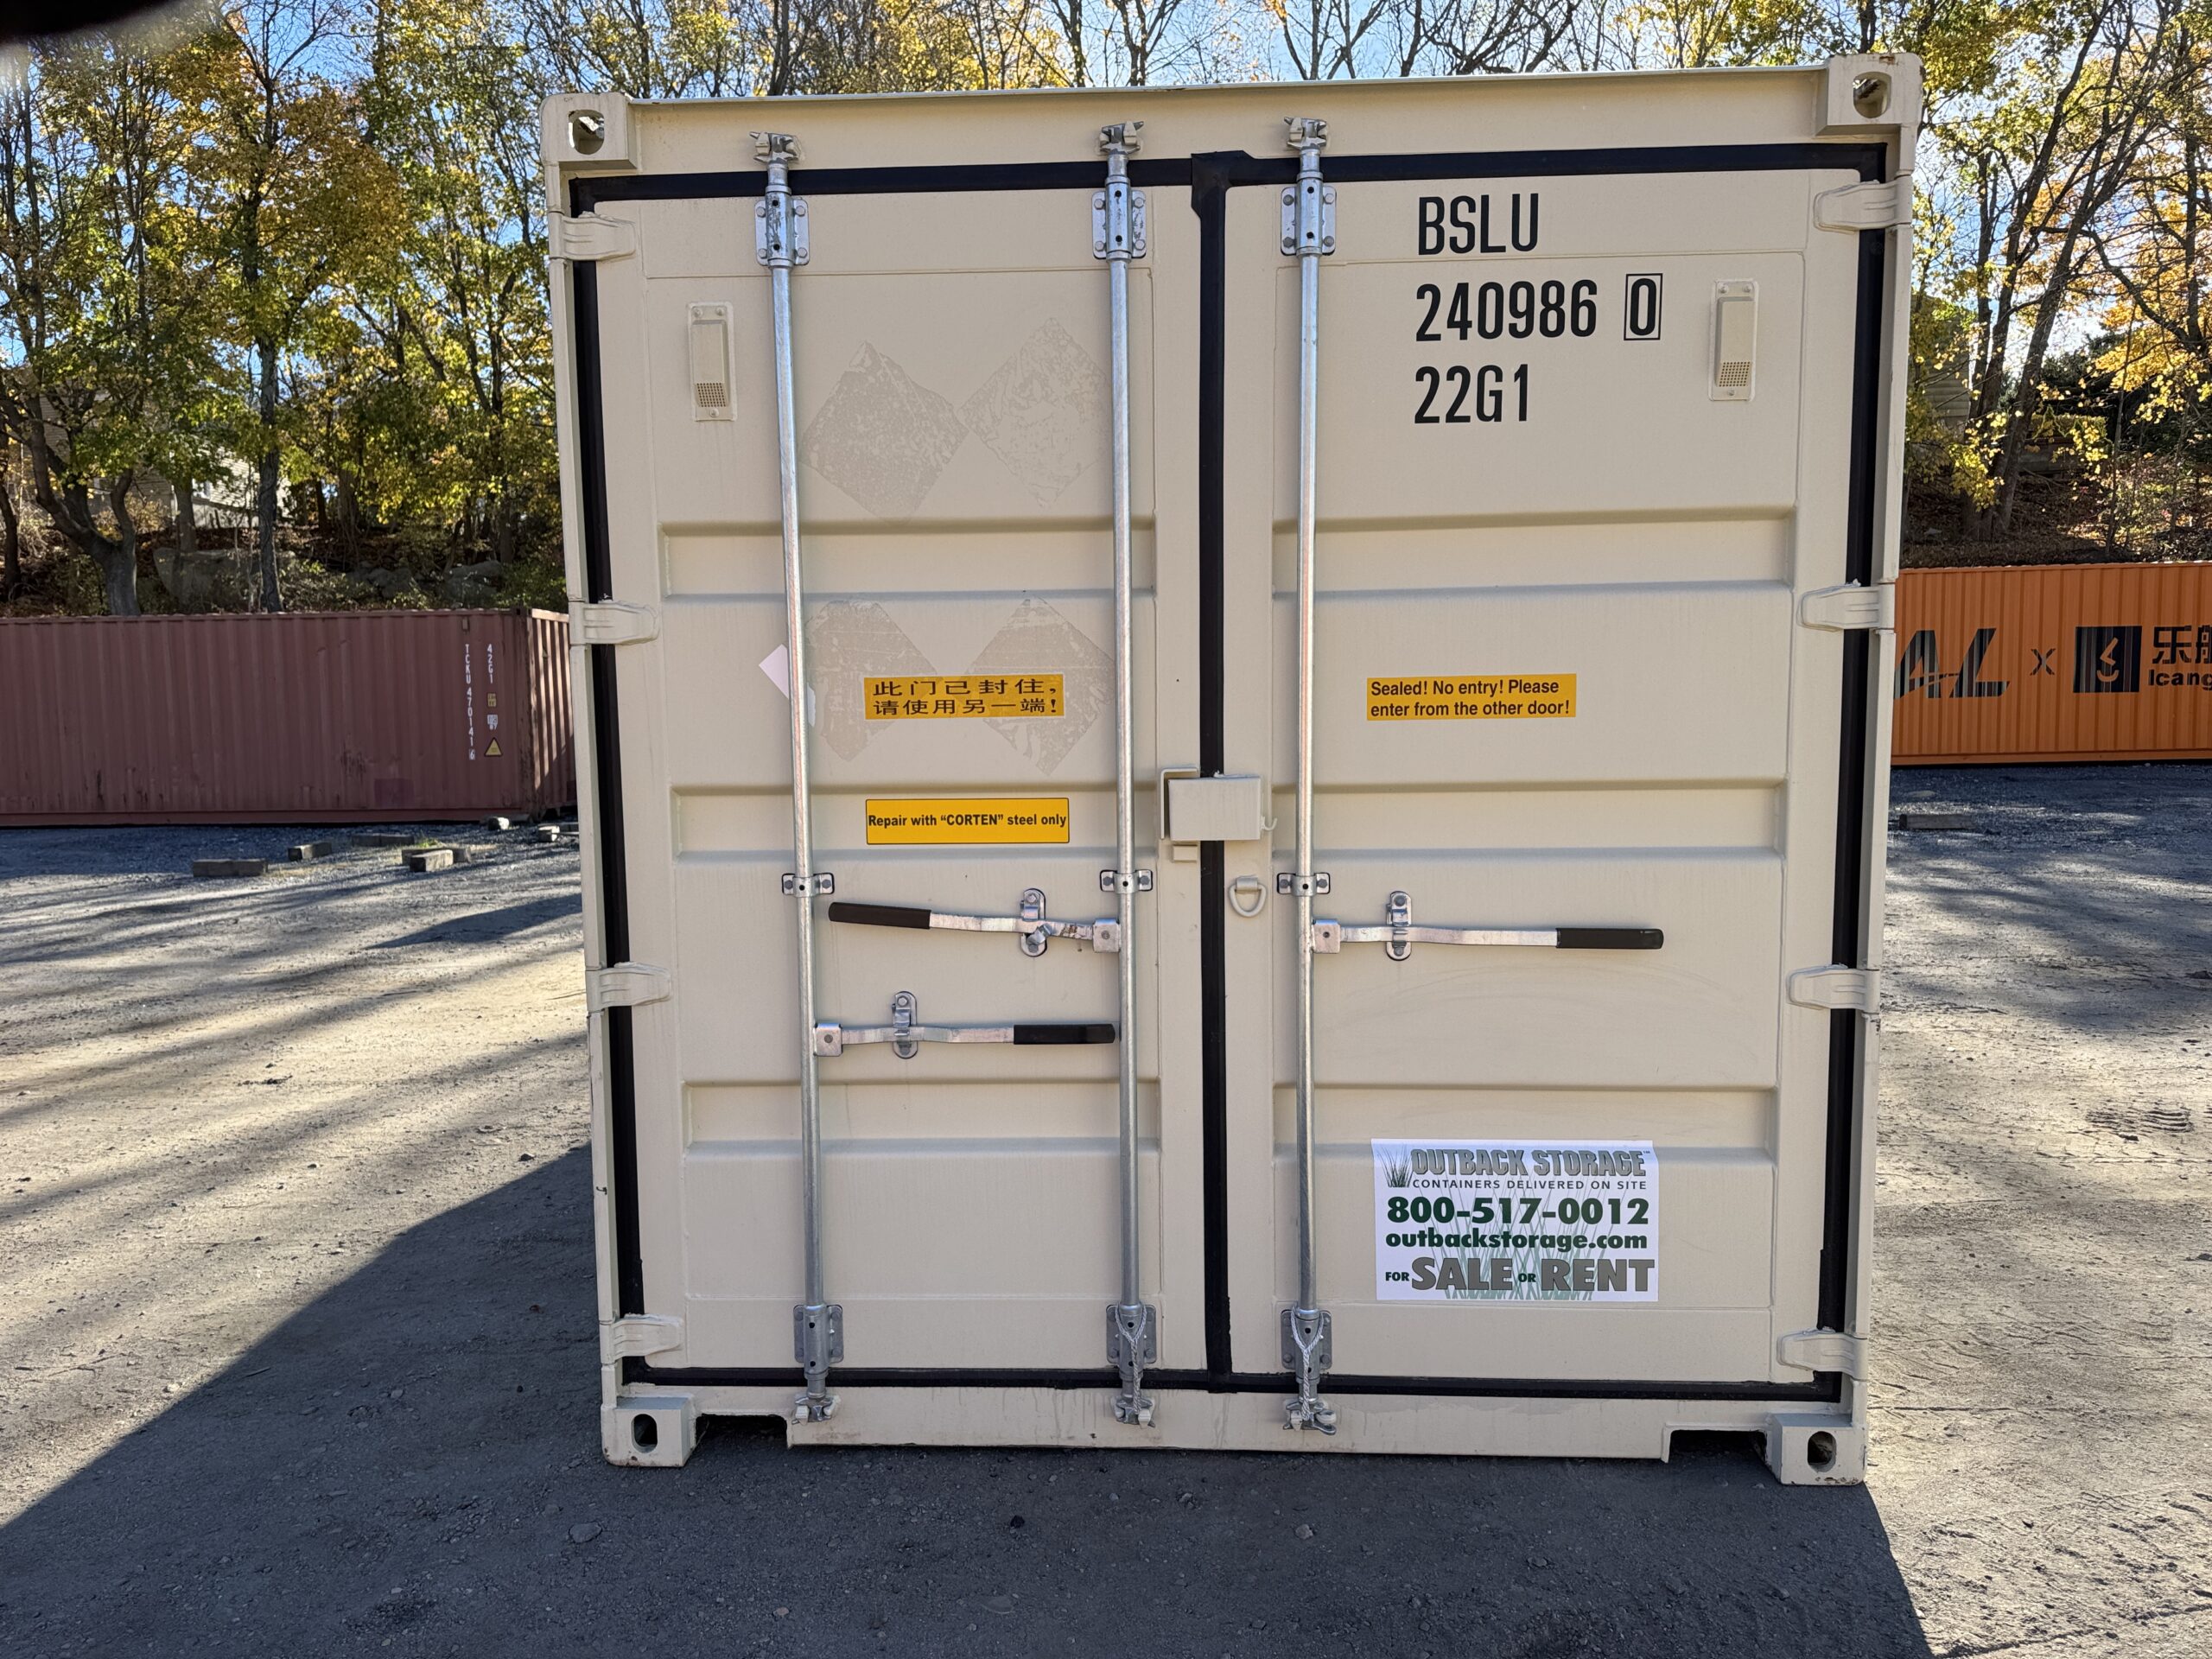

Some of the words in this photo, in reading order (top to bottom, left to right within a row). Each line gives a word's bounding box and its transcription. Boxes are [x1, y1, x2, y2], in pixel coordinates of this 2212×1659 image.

[1418, 193, 1539, 256] BSLU
[1415, 279, 1598, 342] 240986
[1630, 278, 1657, 336] 0
[1414, 364, 1529, 424] 22G1
[1370, 681, 1427, 696] Sealed!
[1433, 681, 1454, 696] No
[1459, 680, 1503, 697] entry!
[1508, 679, 1560, 694] Please
[1370, 702, 1409, 716] enter
[1414, 702, 1449, 716] from
[1453, 702, 1478, 715] the
[1483, 701, 1523, 715] other
[1527, 700, 1570, 715] door!
[868, 815, 907, 829] Repair
[911, 815, 938, 826] with
[1007, 814, 1037, 825] steel
[1041, 814, 1067, 828] only
[1410, 1148, 1529, 1176] OUTBACK
[1531, 1149, 1647, 1177] STORAGE
[1413, 1179, 1501, 1189] CONTAINERS
[1507, 1179, 1584, 1190] DELIVERED
[1591, 1180, 1611, 1190] ON
[1617, 1180, 1647, 1190] SITE
[1387, 1196, 1649, 1225] 800-517-0012
[1385, 1227, 1648, 1253] outbackstorage.com
[1385, 1272, 1410, 1281] FOR
[1411, 1257, 1513, 1290] SALE
[1518, 1273, 1536, 1283] OR
[1541, 1259, 1656, 1292] RENT
